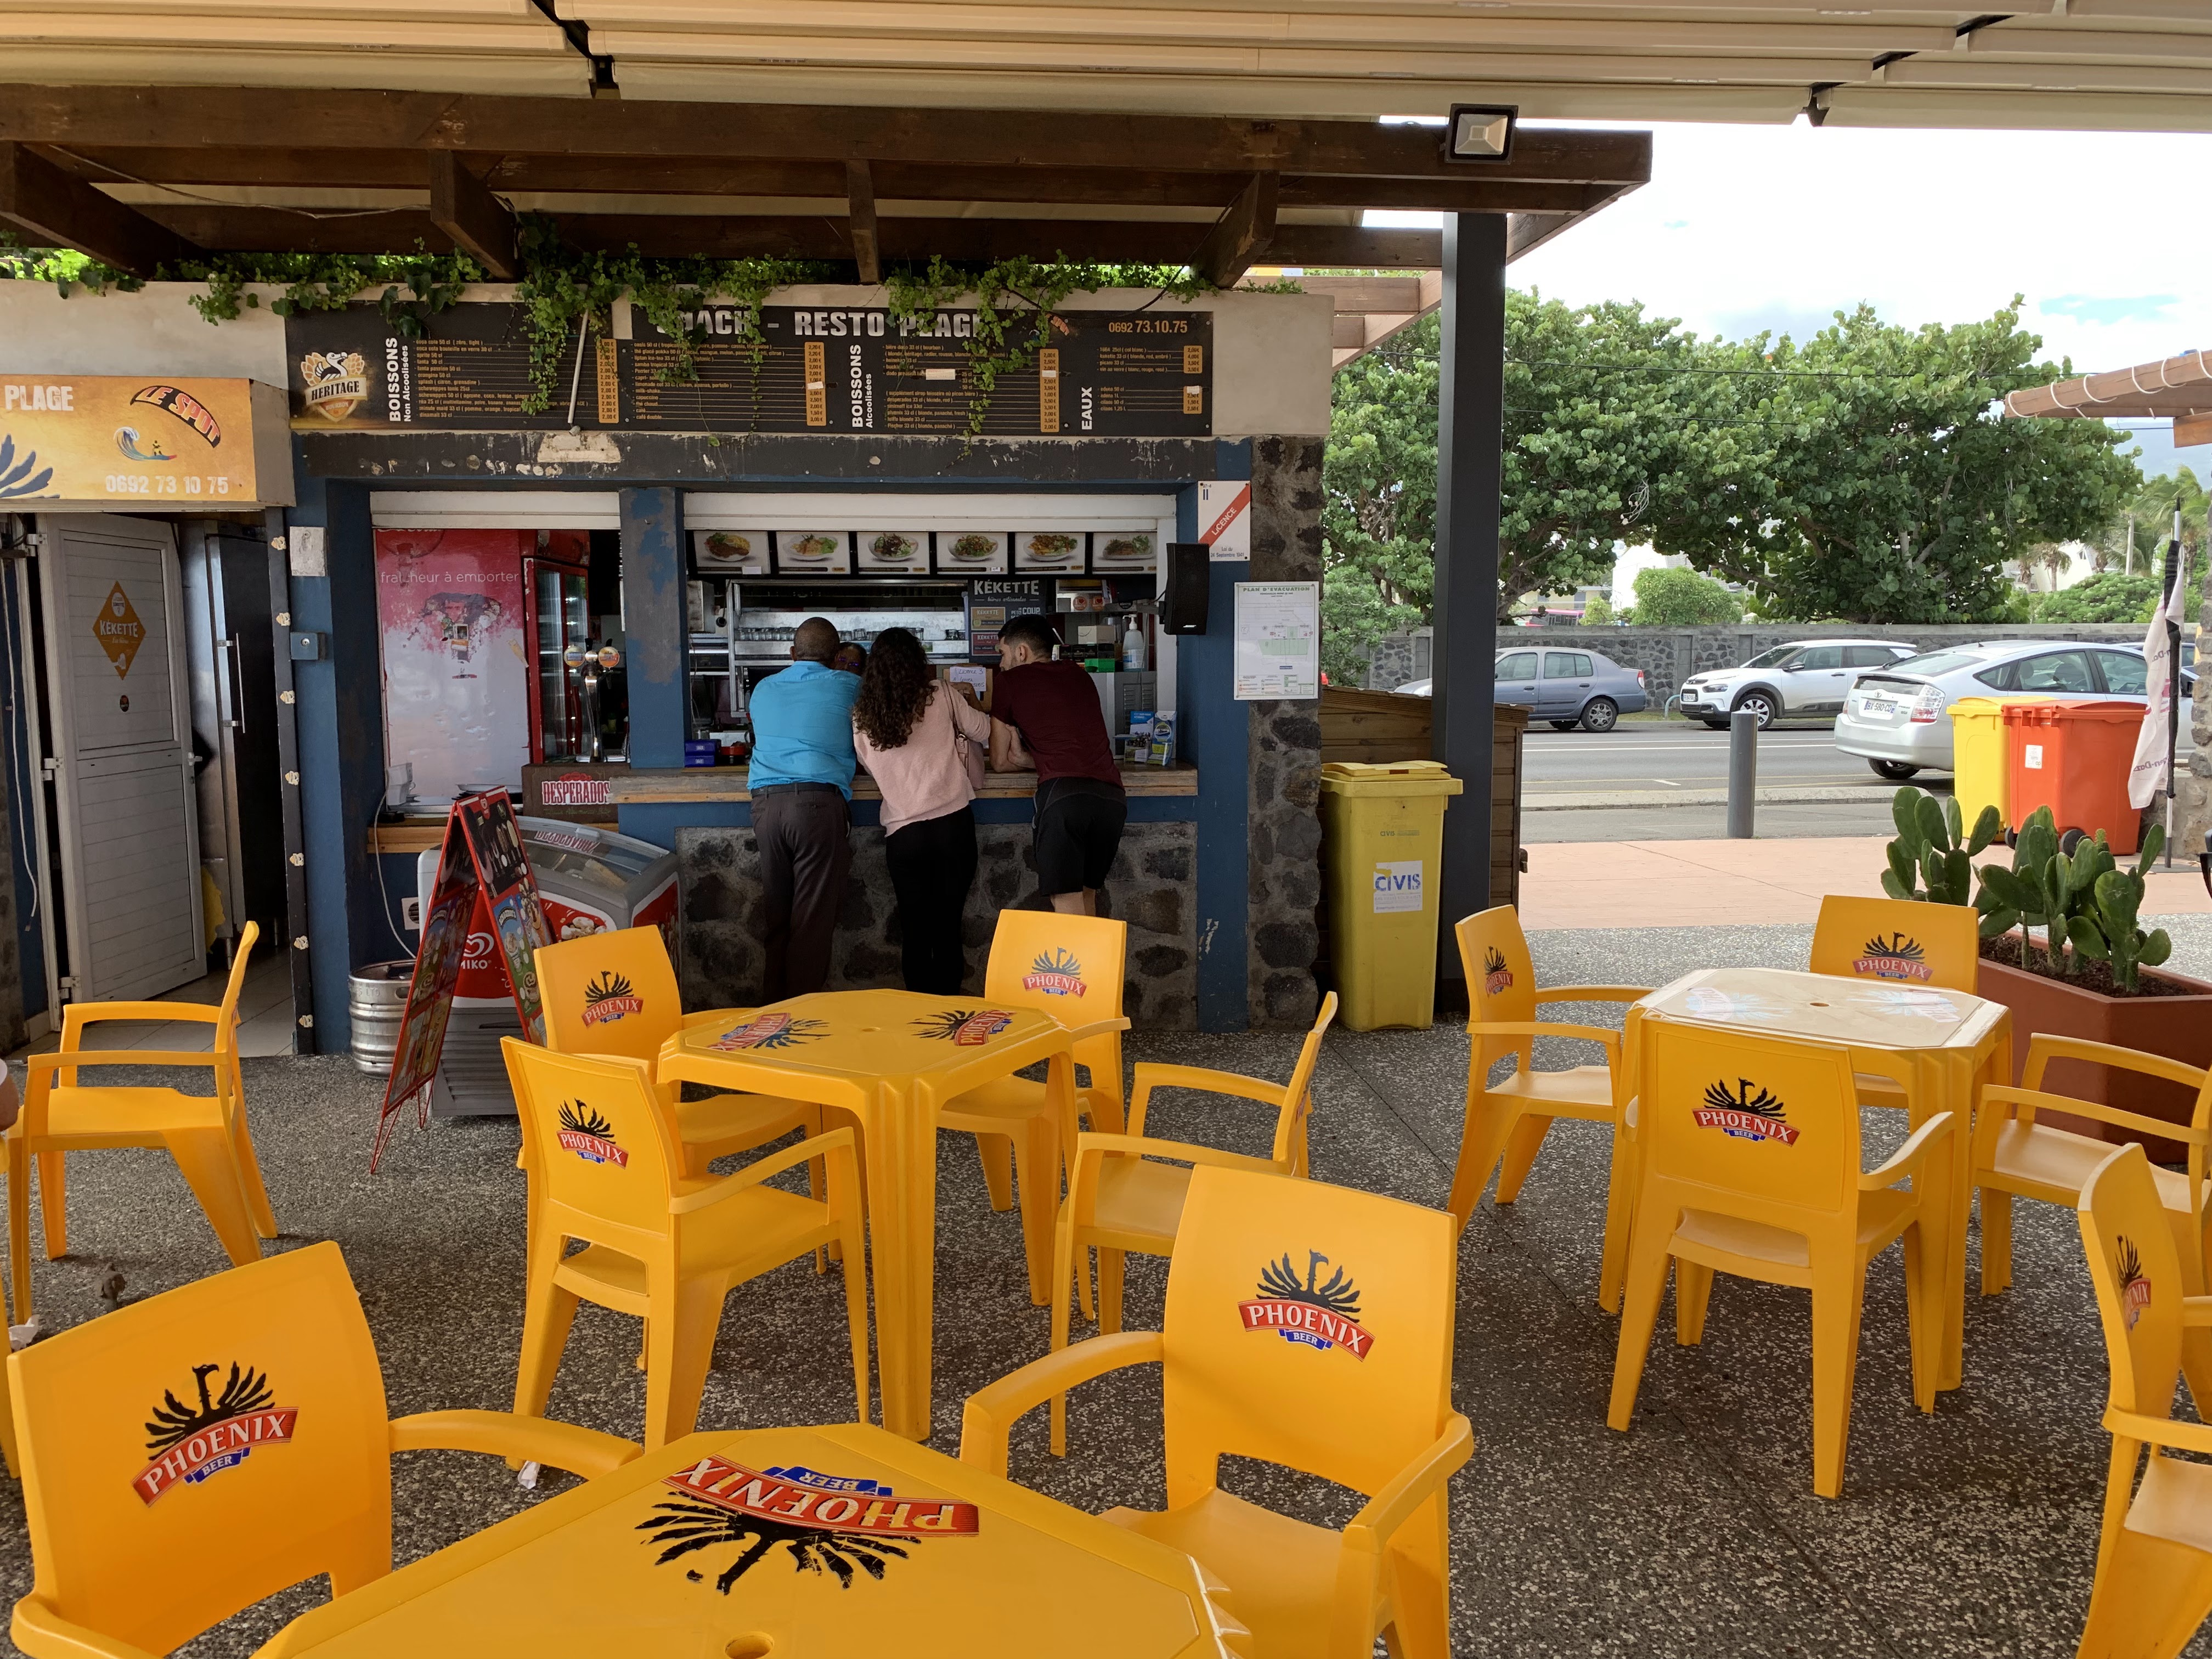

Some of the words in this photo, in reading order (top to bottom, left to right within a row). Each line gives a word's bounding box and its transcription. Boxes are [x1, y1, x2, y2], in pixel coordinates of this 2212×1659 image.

[794, 311, 885, 337] RESTO
[1108, 322, 1133, 334] 0692
[1135, 320, 1188, 334] 73.10.75
[385, 337, 402, 422] BOISSONS
[401, 345, 411, 401] Alcoolisées
[4, 385, 74, 411] PLAGE
[311, 380, 360, 401] HERITAGE
[850, 344, 864, 428] BOISSONS
[403, 403, 411, 422] Non
[865, 373, 873, 428] Alcoolisées
[1081, 386, 1093, 431] EAUX
[135, 386, 172, 405] LE
[168, 393, 220, 442] SPOT
[105, 475, 150, 493] 0692
[155, 475, 177, 494] 73
[183, 476, 201, 494] 10
[207, 476, 229, 494] 75
[1211, 507, 1238, 536] LICENCE
[444, 571, 452, 583] à
[456, 571, 519, 583] emporter
[974, 579, 1040, 595] KÉKETTE
[542, 781, 610, 805] DESPERADOS
[1375, 873, 1421, 892] CIVIS
[1857, 959, 1928, 979] PHOENIX
[1026, 975, 1083, 995] PHOENIX
[585, 998, 639, 1024] PHOENIX
[1699, 1111, 1792, 1143] PHOENIX
[1734, 1130, 1754, 1139] BEER
[561, 1133, 622, 1164] PHOENIX
[583, 1152, 597, 1161] BEER
[1246, 1304, 1365, 1354] PHOENIX
[1293, 1331, 1319, 1346] BEER
[142, 1413, 287, 1495] PHOENIX
[201, 1455, 233, 1477] BEER
[799, 1470, 861, 1492] BEER
[674, 1457, 956, 1531] PHOENIX
